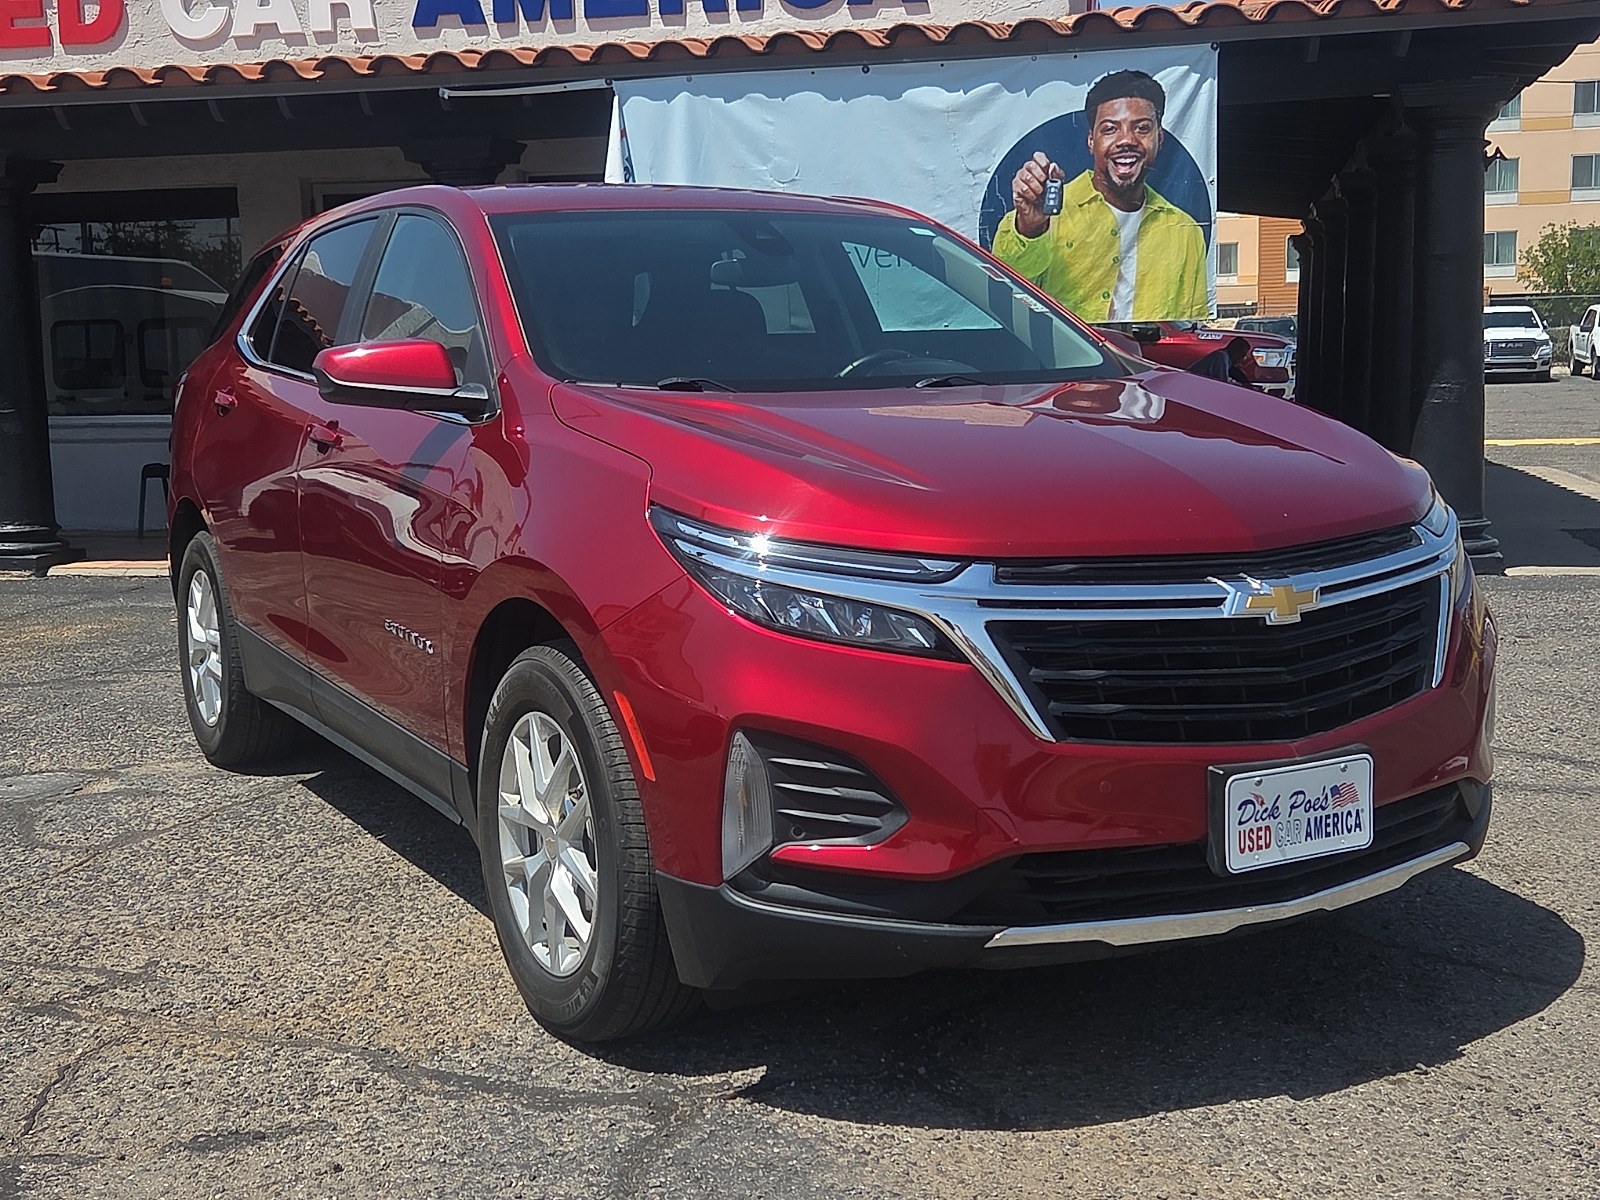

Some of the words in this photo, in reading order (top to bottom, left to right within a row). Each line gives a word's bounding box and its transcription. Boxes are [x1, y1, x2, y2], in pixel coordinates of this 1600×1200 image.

[1237, 795, 1282, 826] Dick
[1288, 787, 1331, 818] Poe's
[1238, 825, 1272, 855] USED
[1275, 819, 1302, 847] CAR
[1304, 808, 1363, 842] AMERICA
